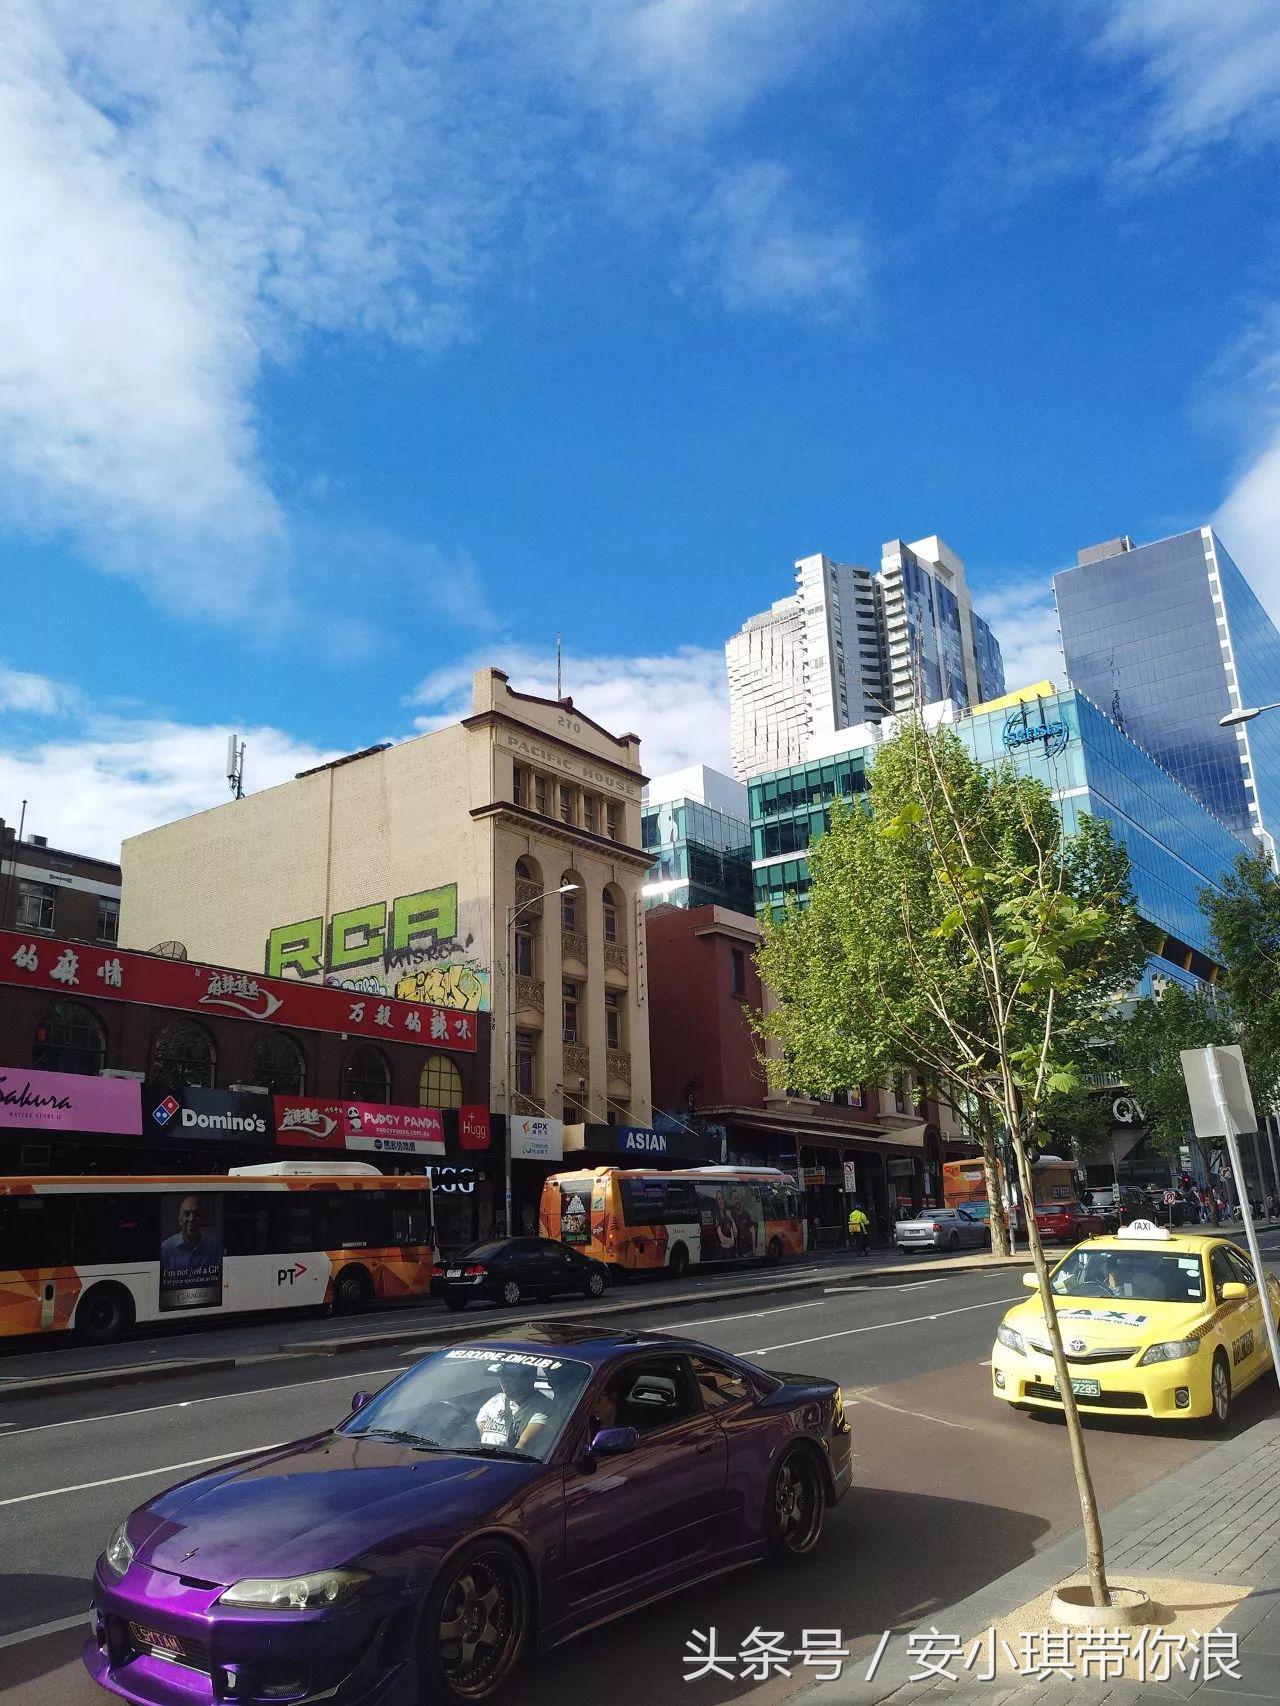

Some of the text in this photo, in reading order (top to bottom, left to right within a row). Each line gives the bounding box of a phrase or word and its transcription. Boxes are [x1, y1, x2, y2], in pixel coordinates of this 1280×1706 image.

[557, 715, 581, 734] 270
[507, 735, 635, 796] PACIFIC HOUSE
[182, 1109, 265, 1133] Domino's
[363, 1112, 441, 1130] PUDGY PANDA
[463, 1120, 486, 1139] Hugg
[532, 1122, 548, 1131] 4PX
[626, 1131, 667, 1152] ASIAN
[1133, 1221, 1151, 1231] TAXI
[163, 1268, 175, 1277] I'm
[177, 1267, 188, 1276] not
[188, 1266, 202, 1277] just
[444, 1350, 506, 1361] MELBOURNE
[522, 1355, 554, 1368] CLUB
